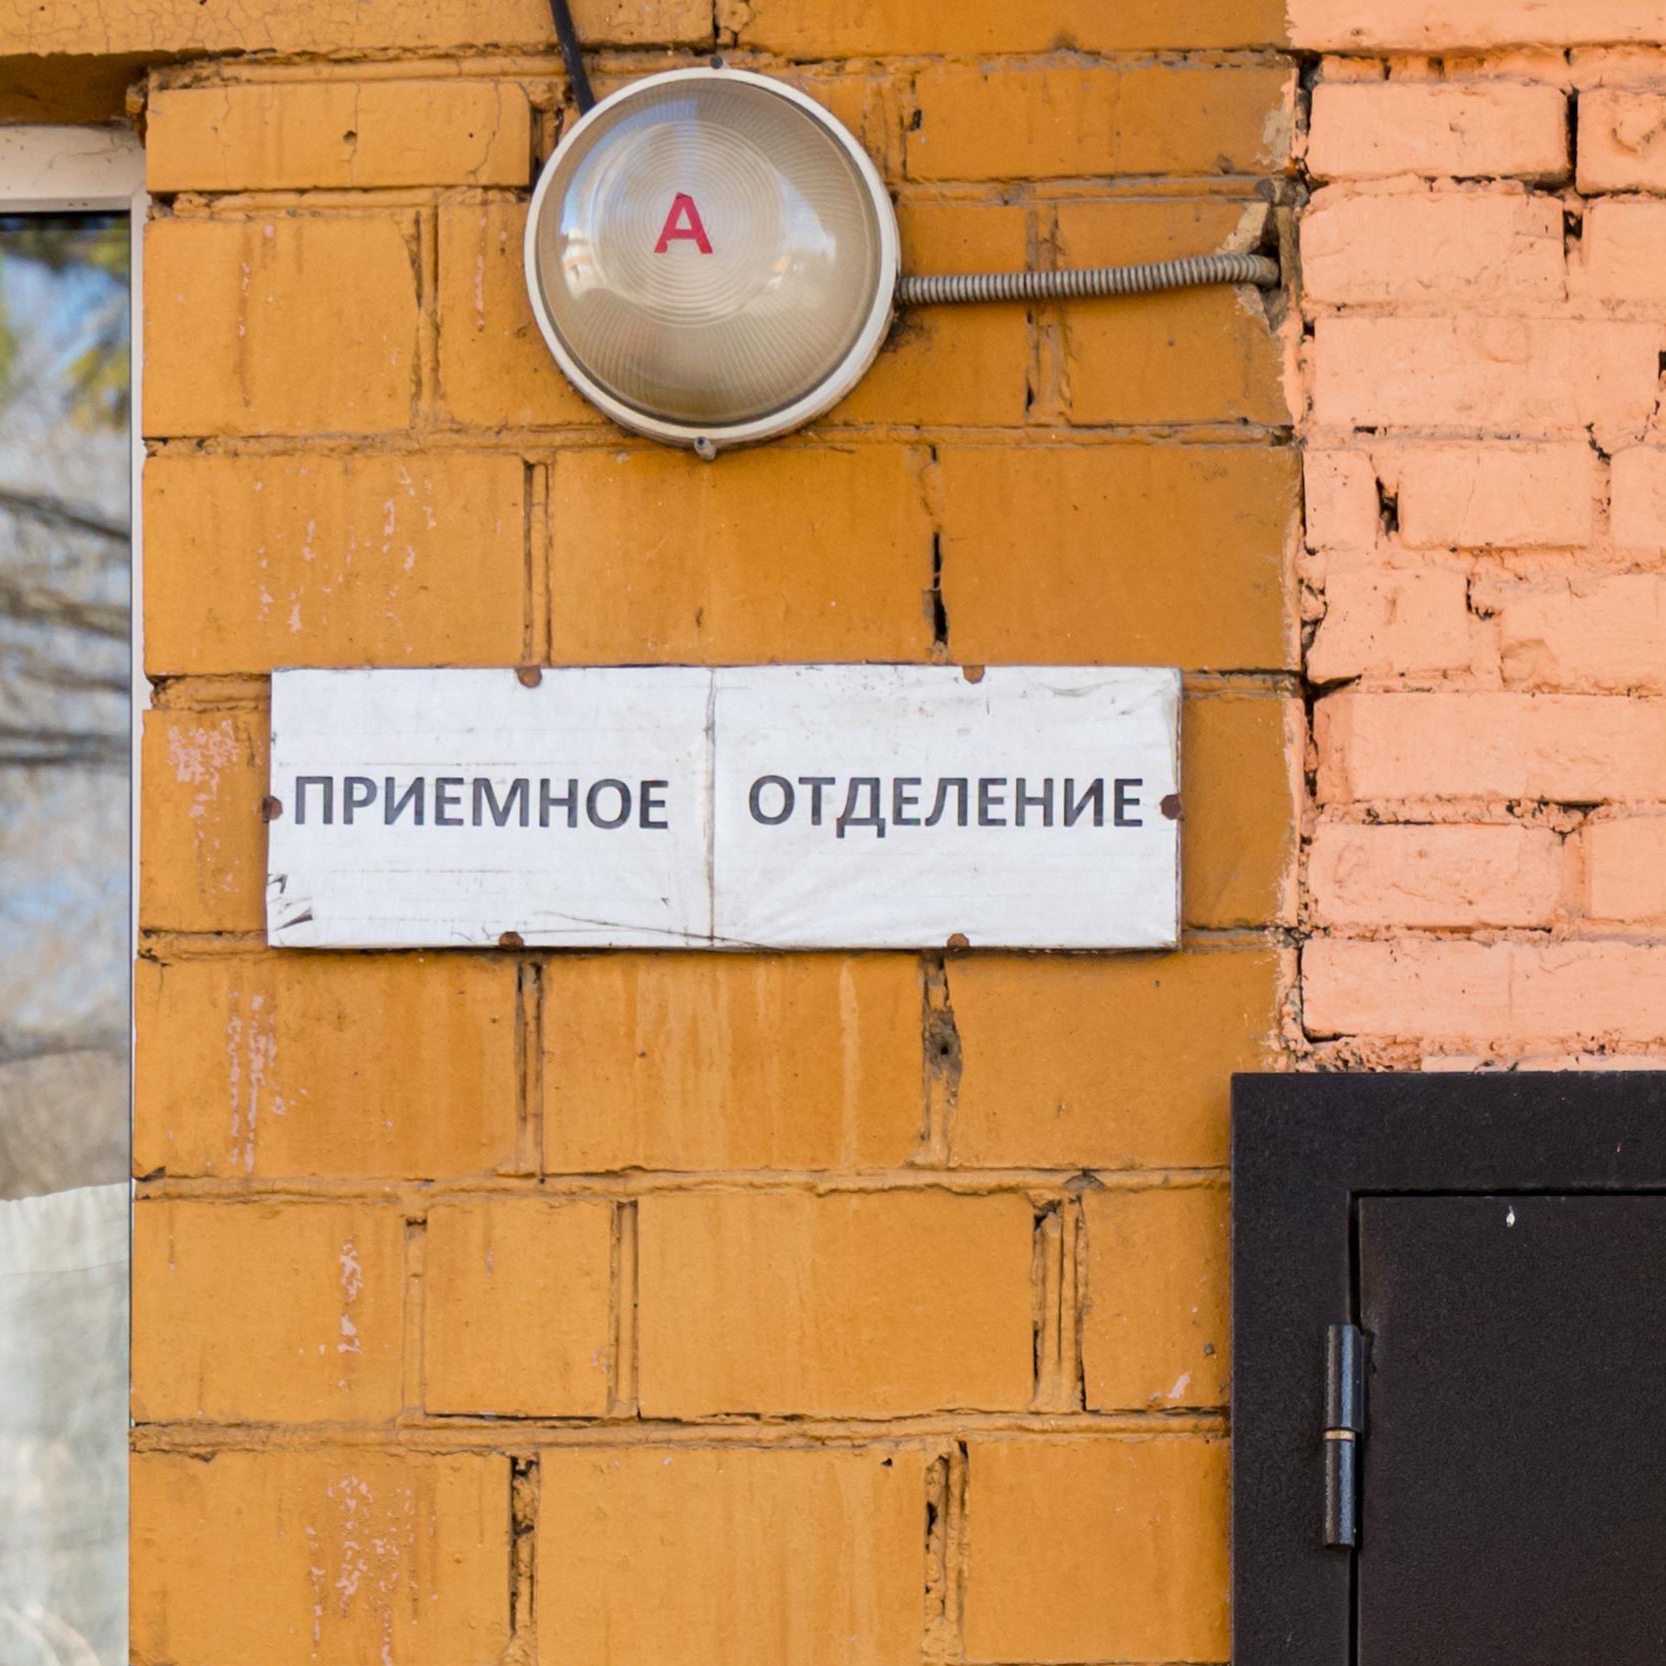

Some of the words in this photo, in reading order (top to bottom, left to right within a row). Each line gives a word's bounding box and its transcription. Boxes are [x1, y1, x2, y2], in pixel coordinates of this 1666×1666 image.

[654, 193, 713, 253] А
[295, 776, 668, 829] ПРИЕМНОЕ
[749, 774, 1143, 838] ОТДЕЛЕНИЕ
